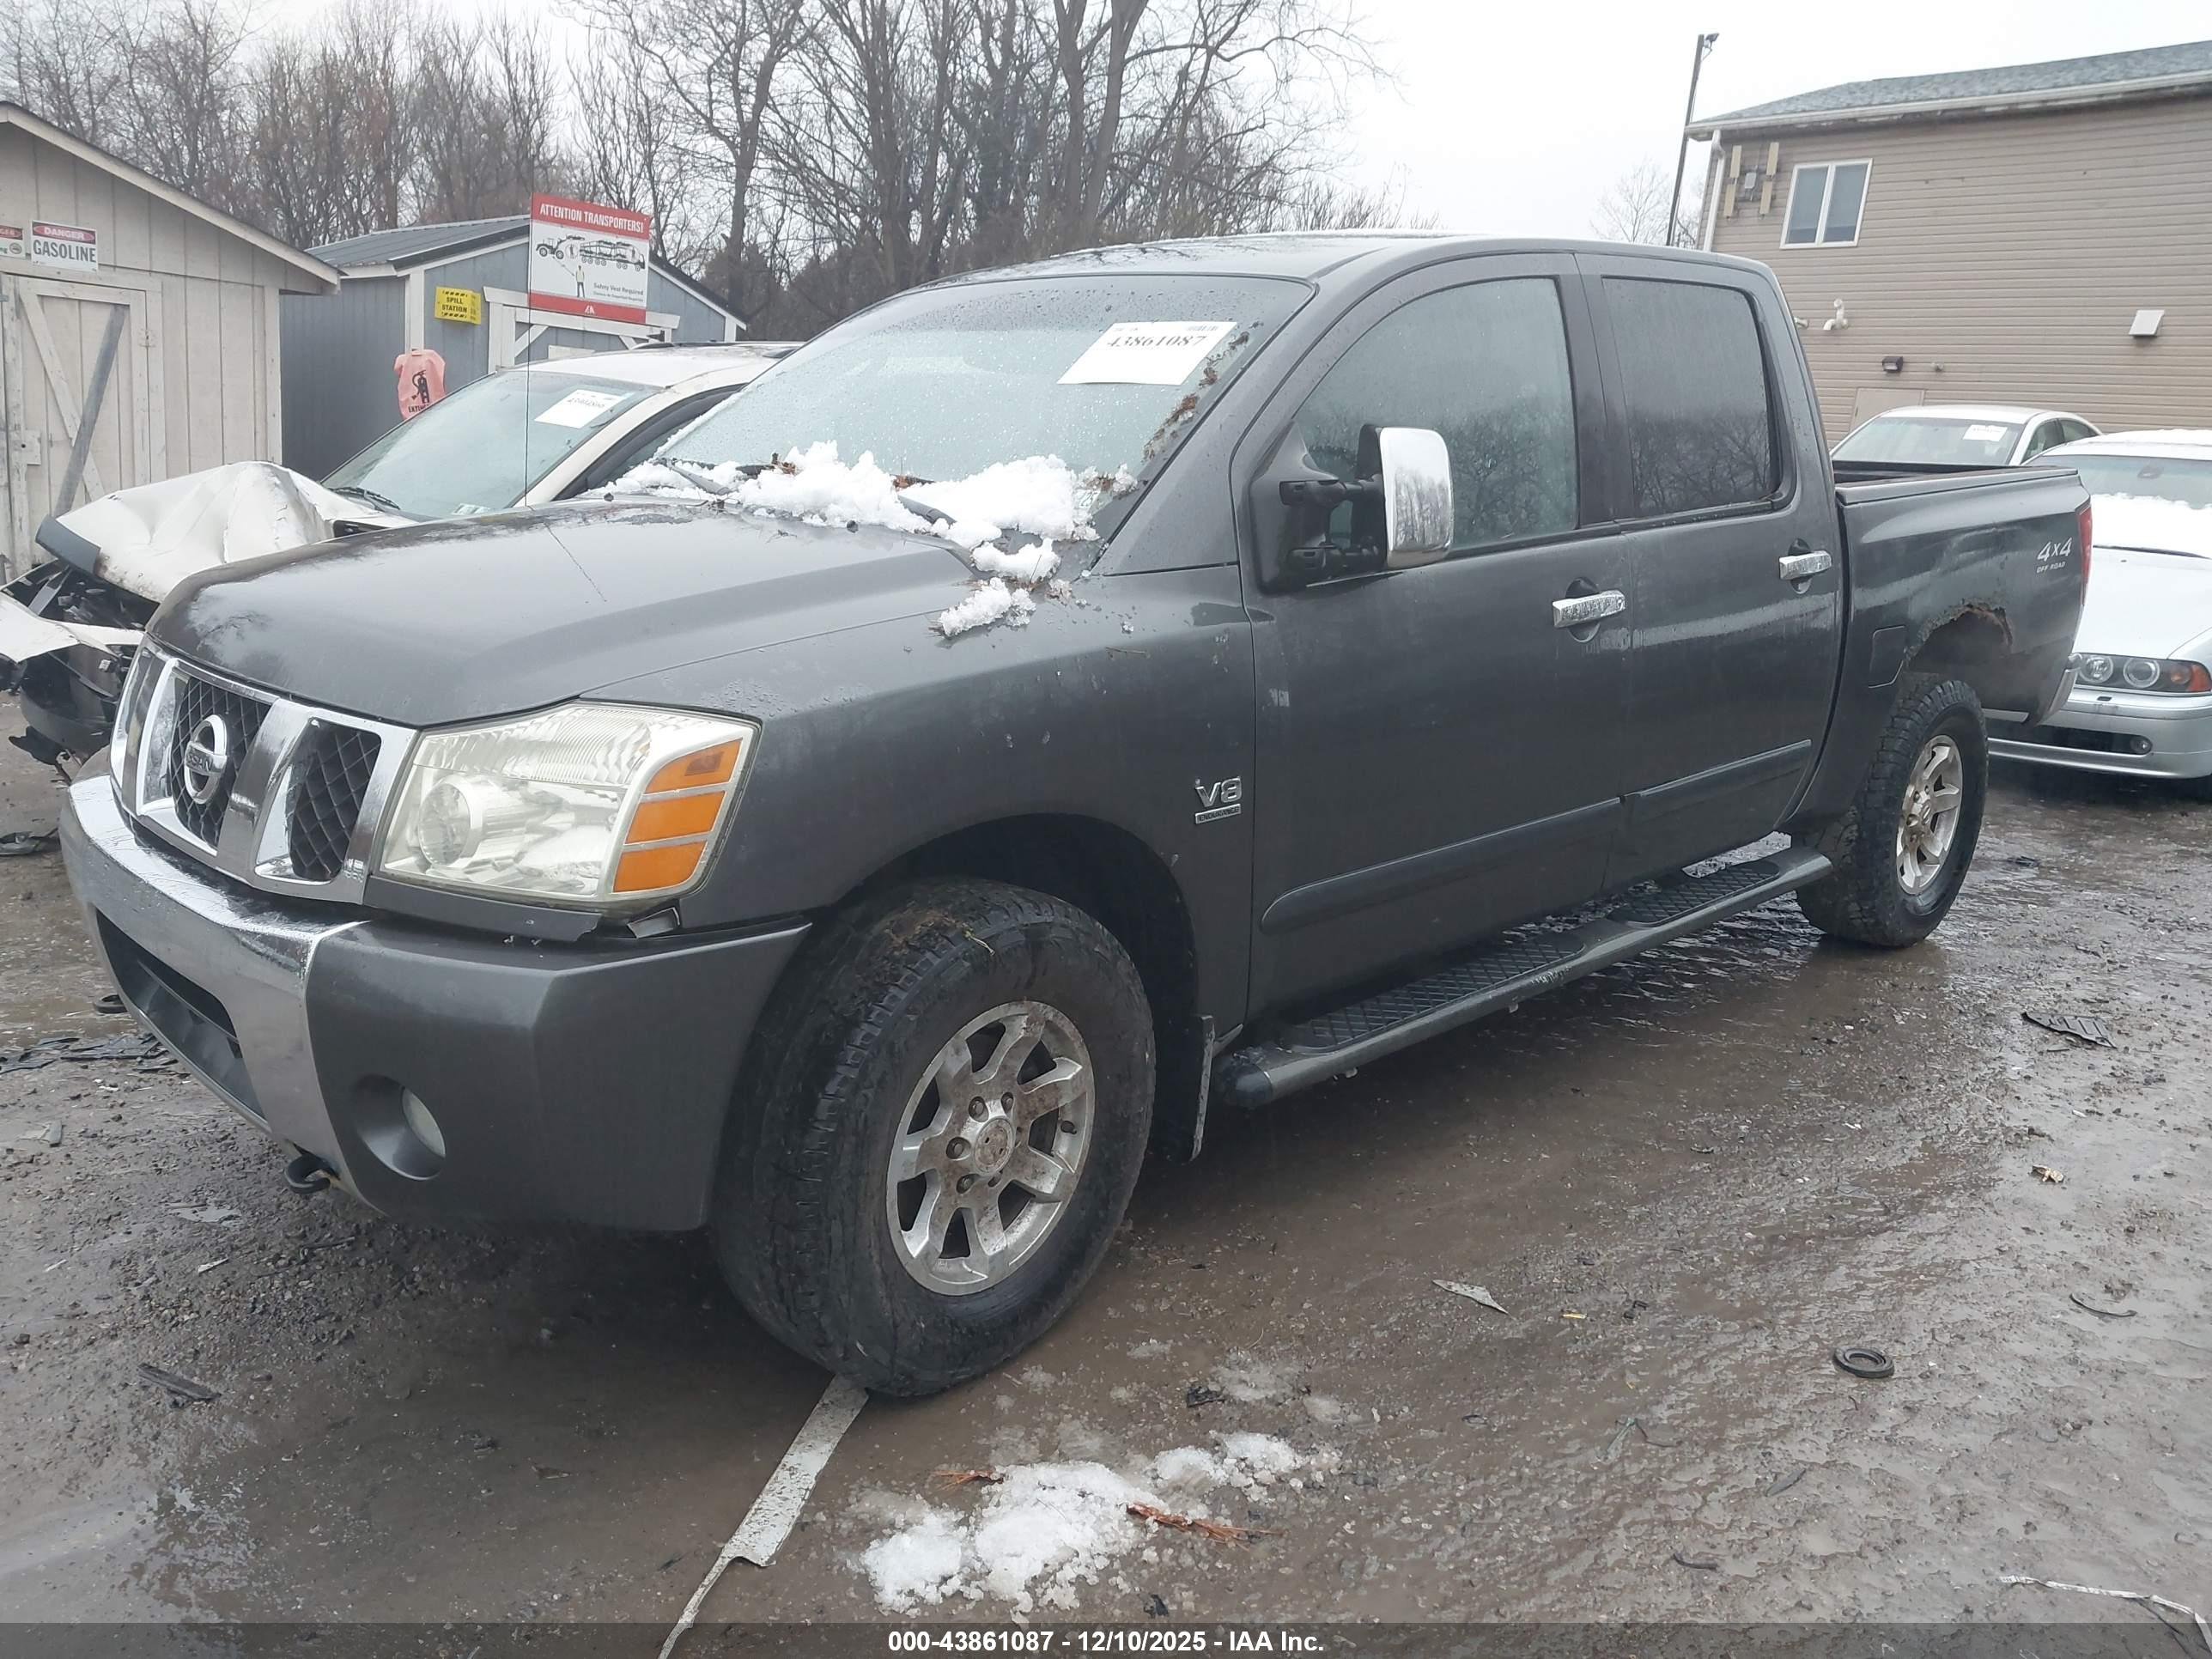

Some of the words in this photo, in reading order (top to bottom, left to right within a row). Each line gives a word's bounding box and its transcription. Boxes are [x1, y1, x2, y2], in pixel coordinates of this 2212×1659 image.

[540, 204, 582, 222] ATTENTION
[584, 211, 644, 234] TRANSPORTERS!
[44, 227, 84, 240] DANGER
[33, 239, 96, 263] GASOLINE
[447, 296, 463, 305] SPILL
[441, 304, 467, 313] STATION
[1107, 336, 1207, 346] 43861087
[1195, 776, 1242, 807] V8
